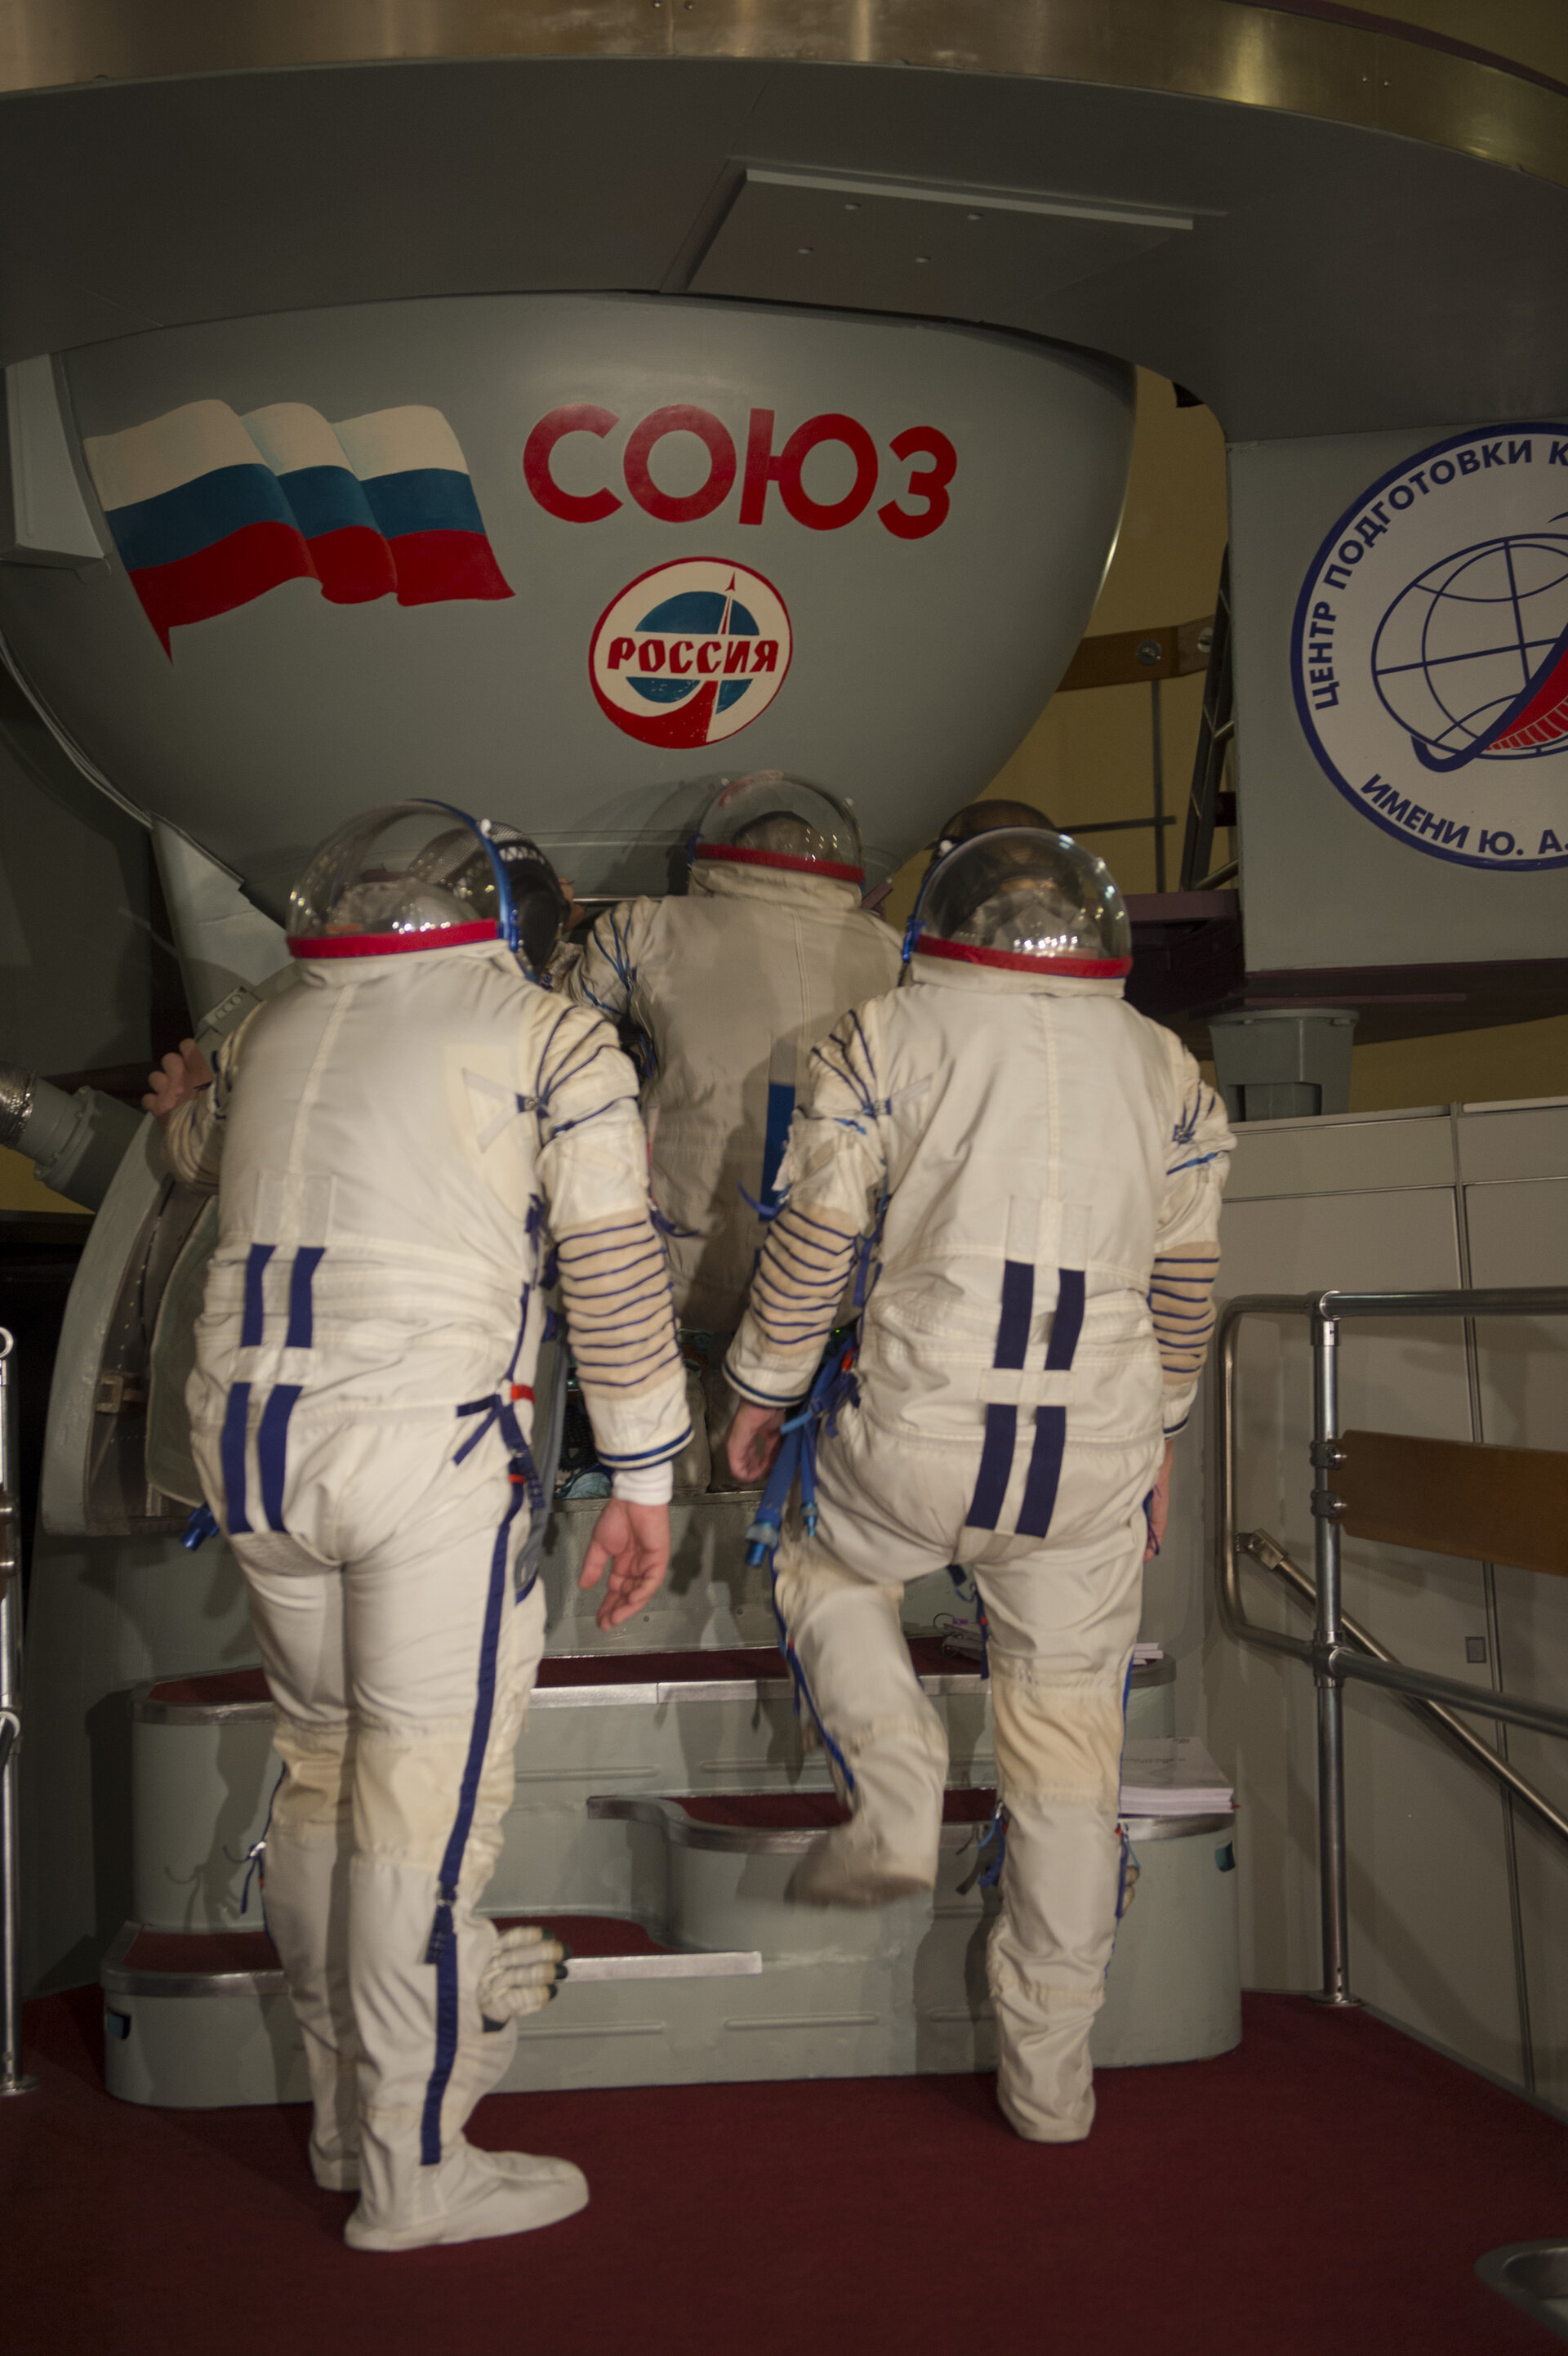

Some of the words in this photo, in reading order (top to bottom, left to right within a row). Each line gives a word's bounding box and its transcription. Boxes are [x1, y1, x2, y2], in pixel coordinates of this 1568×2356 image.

[523, 403, 957, 540] СОЮЗ
[1323, 440, 1532, 590] ПОДГОТОВКИ
[606, 636, 779, 674] РОССИЯ
[1308, 600, 1339, 710] ЦЕНТР
[1361, 774, 1470, 849] ИМЕНИ
[1478, 830, 1523, 855] Ю.
